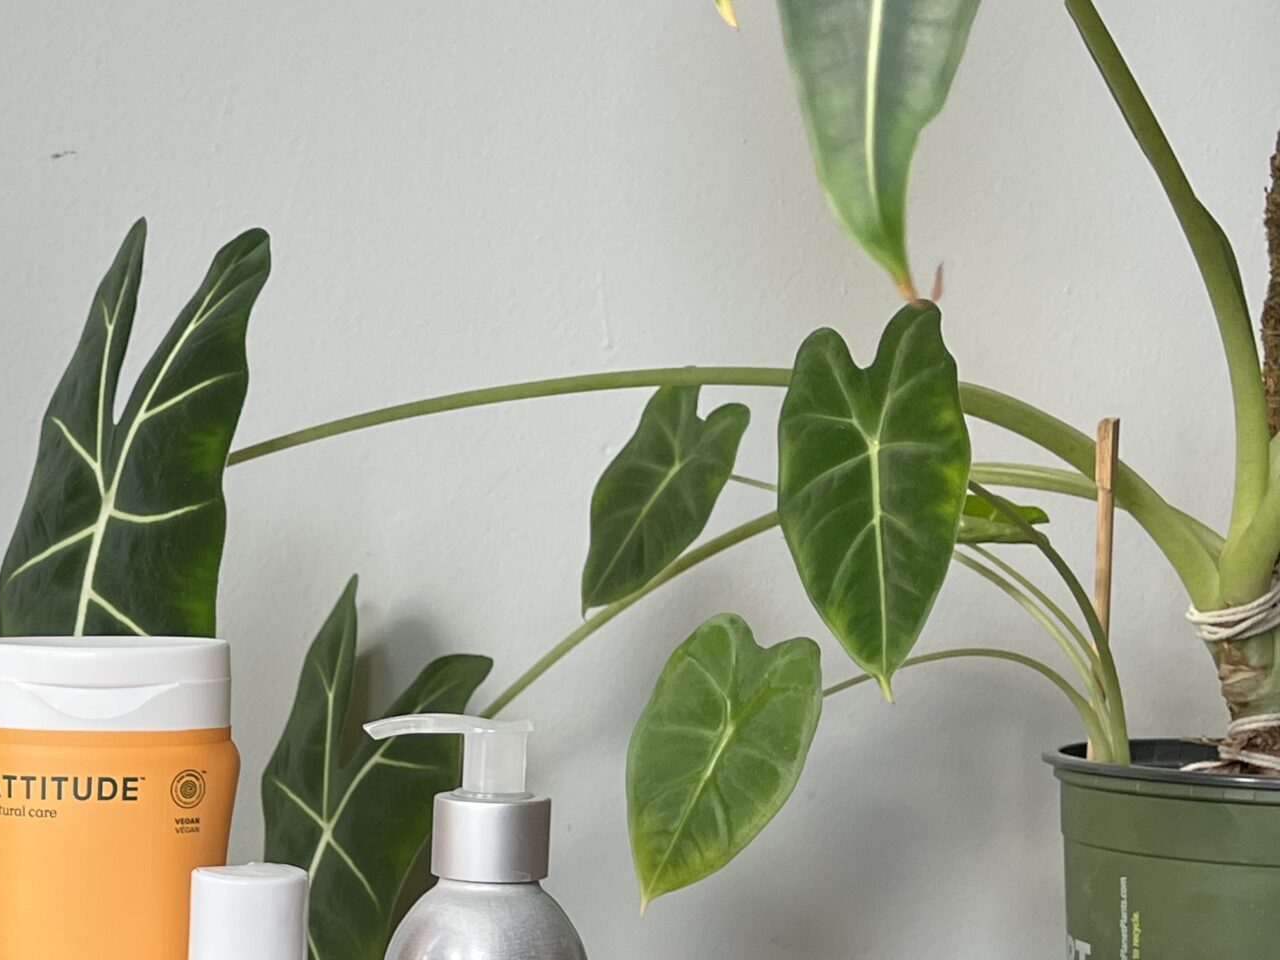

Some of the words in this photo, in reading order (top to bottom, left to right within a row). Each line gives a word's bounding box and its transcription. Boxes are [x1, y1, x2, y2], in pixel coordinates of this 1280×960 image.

[28, 808, 57, 819] care
[175, 817, 200, 825] VEGAN
[175, 826, 200, 834] VEGAN
